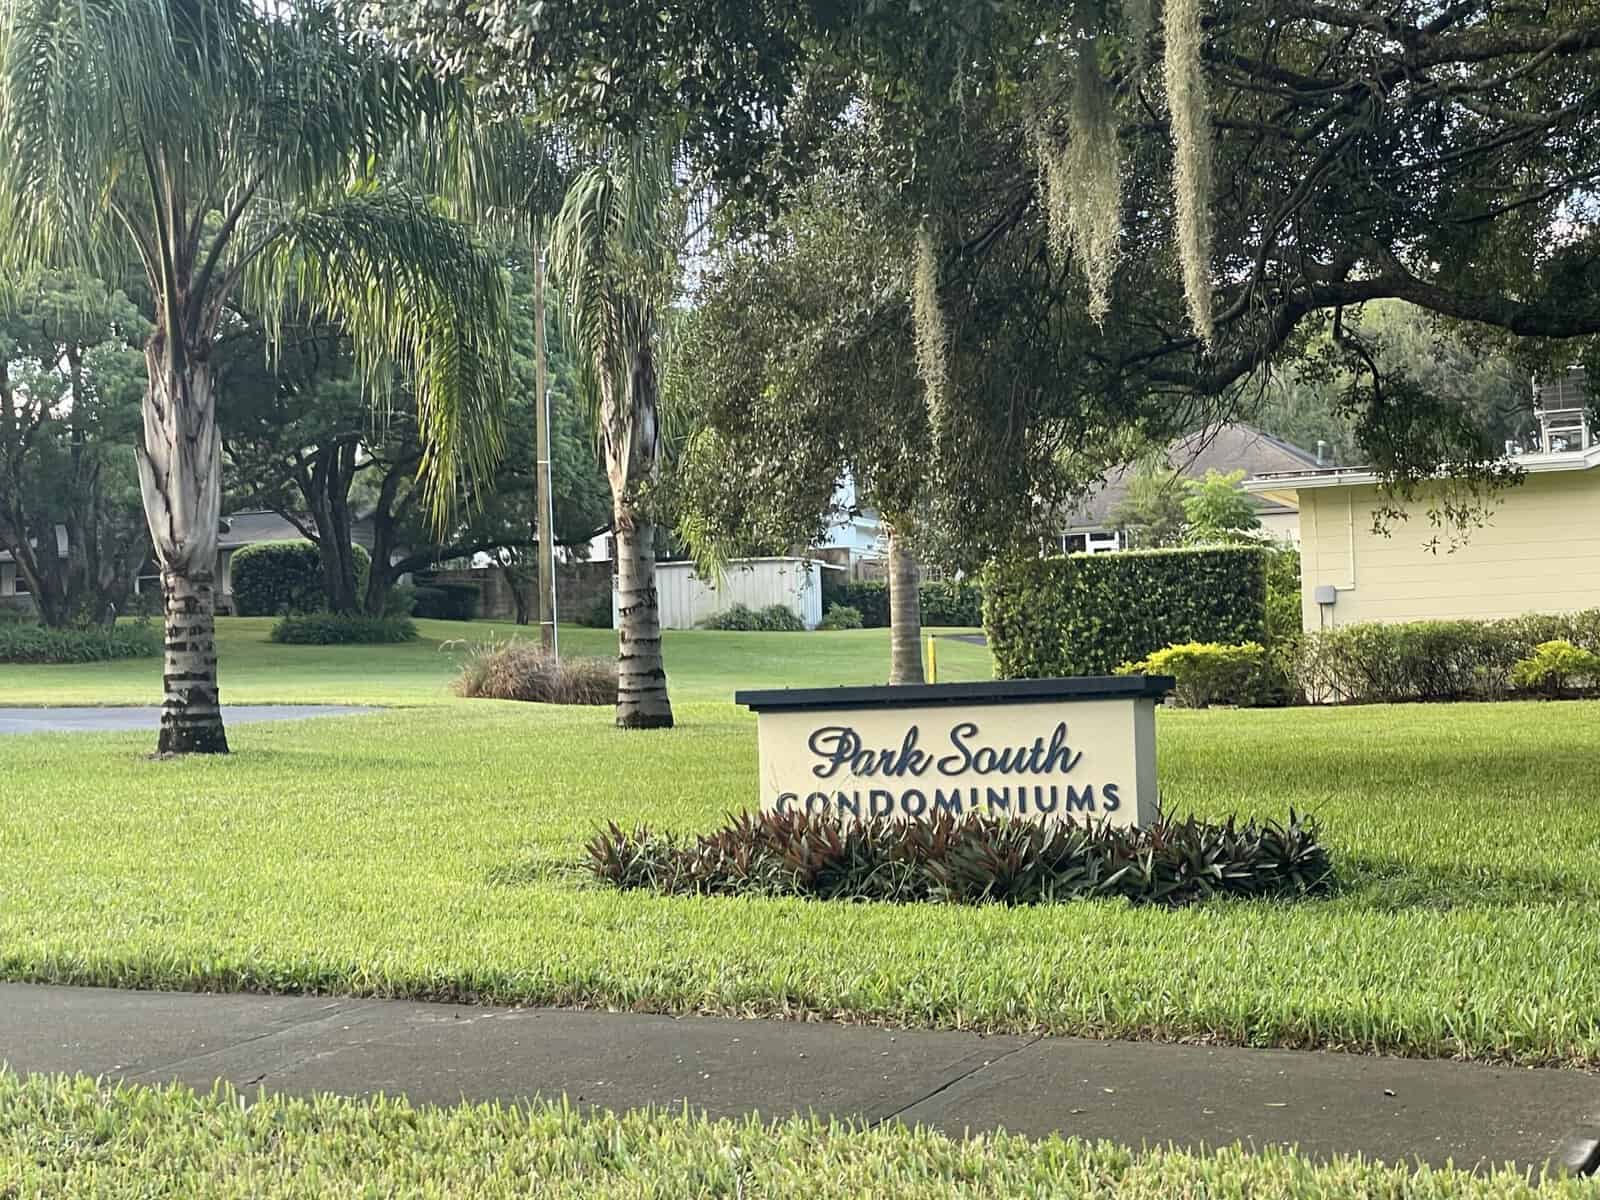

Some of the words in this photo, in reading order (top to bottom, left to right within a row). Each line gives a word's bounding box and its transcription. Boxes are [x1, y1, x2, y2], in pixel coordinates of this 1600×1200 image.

[808, 725, 934, 778] Park
[937, 721, 1082, 776] South
[776, 783, 1121, 818] CONDOMINIUMS
